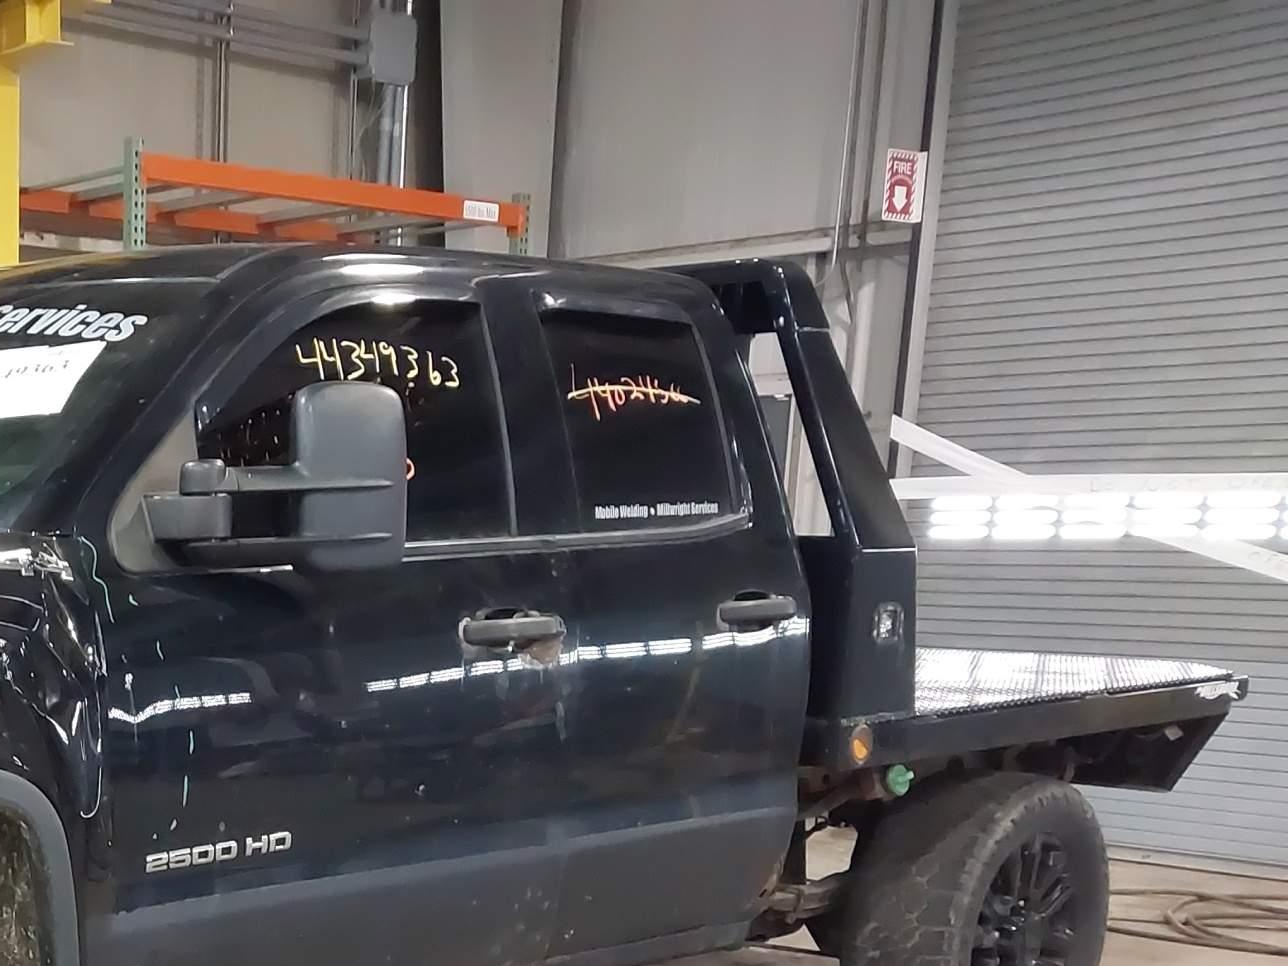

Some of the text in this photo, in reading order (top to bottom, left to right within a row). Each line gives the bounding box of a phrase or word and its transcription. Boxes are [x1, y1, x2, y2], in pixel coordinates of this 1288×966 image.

[893, 160, 913, 175] FIRE
[295, 337, 460, 388] 44349363
[595, 500, 719, 519] Mobile Welding Millwright Services
[145, 831, 292, 873] 2500 HD
